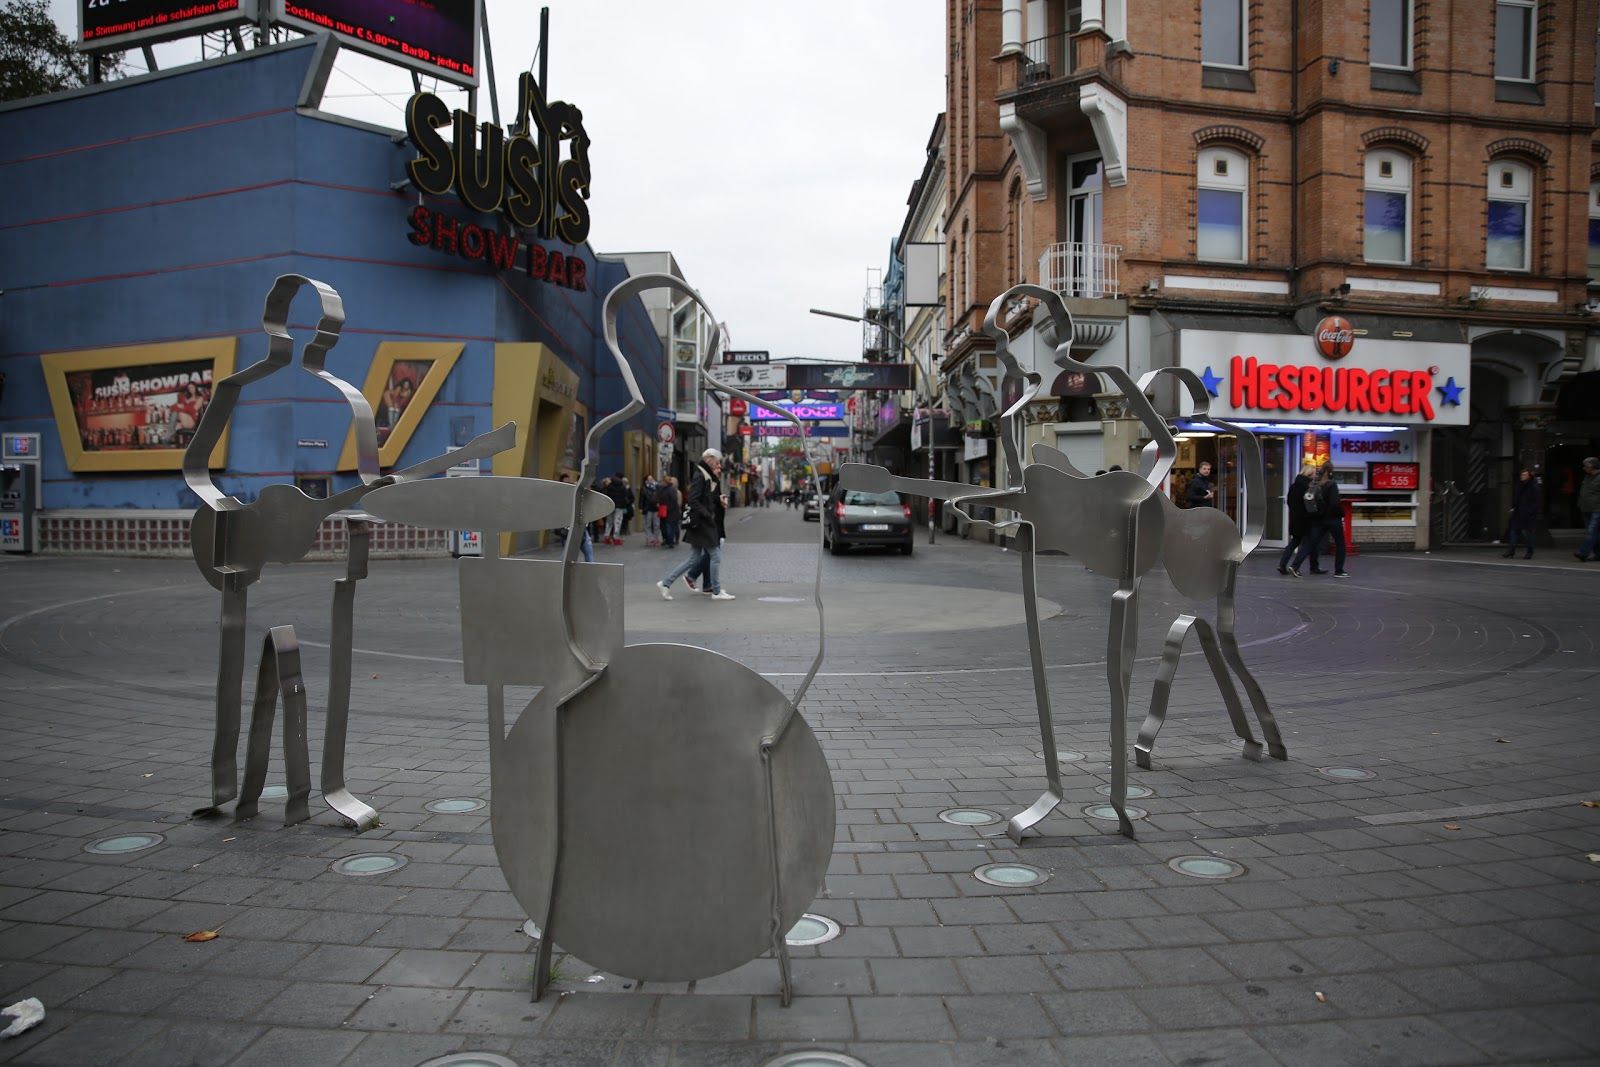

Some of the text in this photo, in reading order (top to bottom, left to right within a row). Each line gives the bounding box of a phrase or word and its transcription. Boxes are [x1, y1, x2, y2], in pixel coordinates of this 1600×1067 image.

[95, 20, 136, 36] Stimmung
[137, 14, 155, 28] und
[155, 10, 168, 23] die
[170, 2, 216, 21] schärfsten
[217, 0, 238, 11] Girls
[285, 2, 334, 28] Cocktails
[336, 19, 354, 34] nur
[356, 27, 364, 39] €
[401, 42, 430, 61] Bar99
[437, 55, 460, 71] jeder
[408, 205, 586, 291] SHOW BAR
[1230, 355, 1435, 422] HESBURGER
[1341, 438, 1401, 454] HESBURGER
[462, 541, 478, 549] ATM
